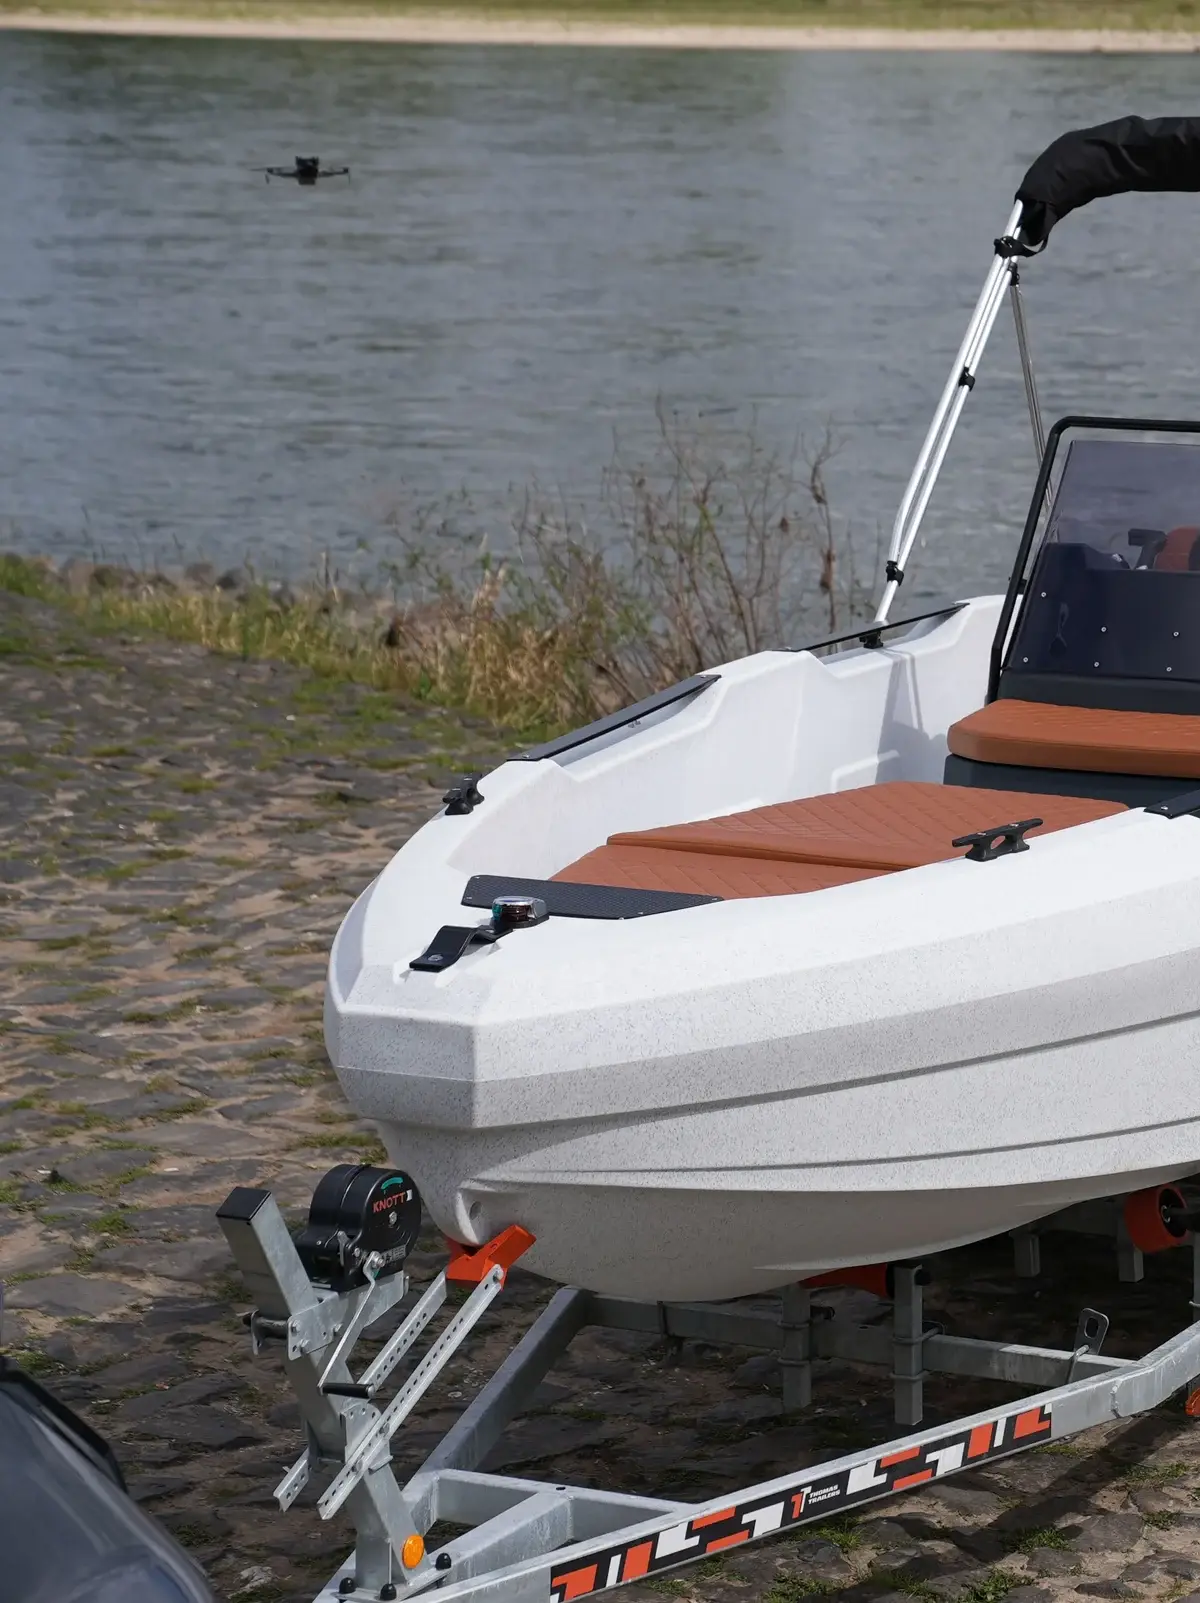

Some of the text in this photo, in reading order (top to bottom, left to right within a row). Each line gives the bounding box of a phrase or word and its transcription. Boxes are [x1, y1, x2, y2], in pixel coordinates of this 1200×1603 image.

[373, 1192, 406, 1213] KNOTT
[808, 1489, 841, 1504] TRAILERS
[809, 1484, 839, 1498] THOMAS
